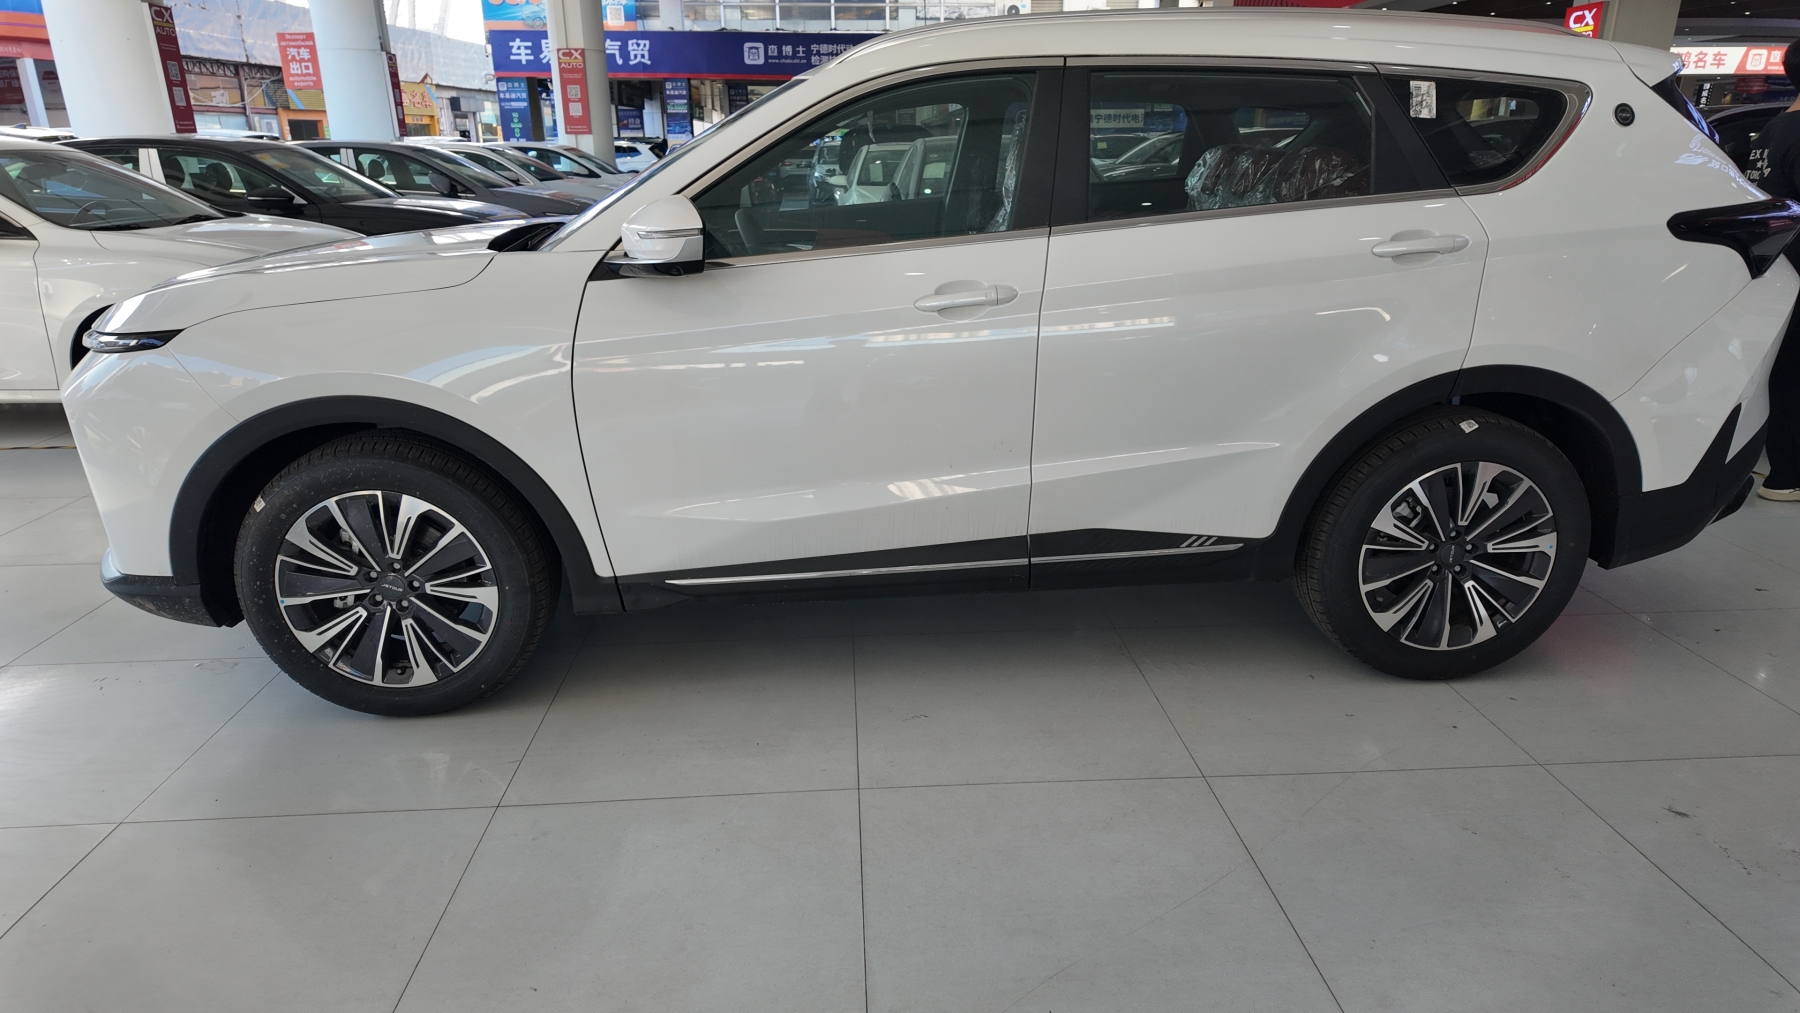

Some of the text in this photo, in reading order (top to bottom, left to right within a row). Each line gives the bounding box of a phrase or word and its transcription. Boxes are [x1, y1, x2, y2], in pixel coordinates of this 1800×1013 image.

[150, 6, 174, 24] CX
[1569, 7, 1598, 29] CX
[155, 26, 176, 37] AUTO
[286, 47, 312, 61] 汽车
[558, 49, 583, 60] CX
[768, 45, 807, 57] 查博士
[289, 61, 314, 75] 出口
